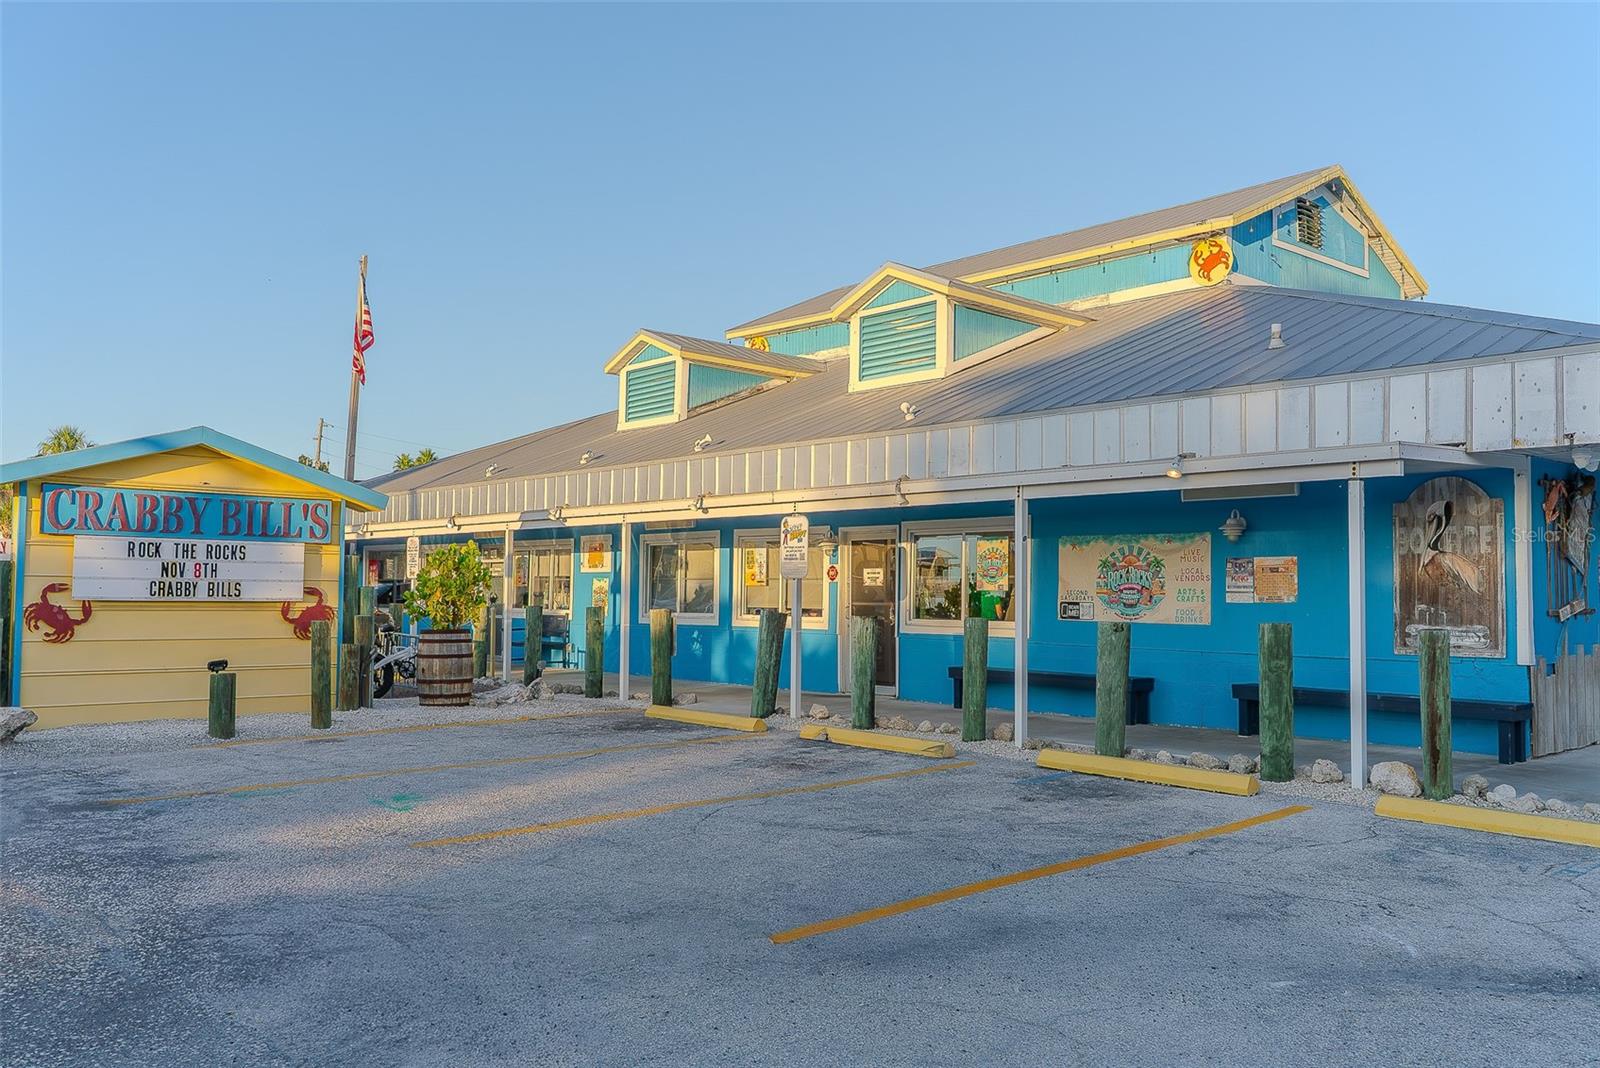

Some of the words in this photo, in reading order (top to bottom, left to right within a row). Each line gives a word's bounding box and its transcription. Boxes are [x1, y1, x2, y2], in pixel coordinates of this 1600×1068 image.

[47, 487, 211, 534] CRABBY
[218, 498, 330, 540] BILL'S
[127, 541, 162, 558] ROCK
[174, 542, 197, 559] THE
[206, 543, 247, 560] ROCKS
[161, 562, 185, 578] NOV
[194, 562, 218, 578] 8TH
[1180, 567, 1204, 575] LOCAL
[1175, 574, 1211, 582] VENDORS
[149, 580, 198, 597] CRABBY
[207, 582, 242, 598] BILLS
[1176, 595, 1206, 603] CRAFTS
[1175, 608, 1196, 616] FOOD
[1174, 615, 1204, 623] DRINKS
